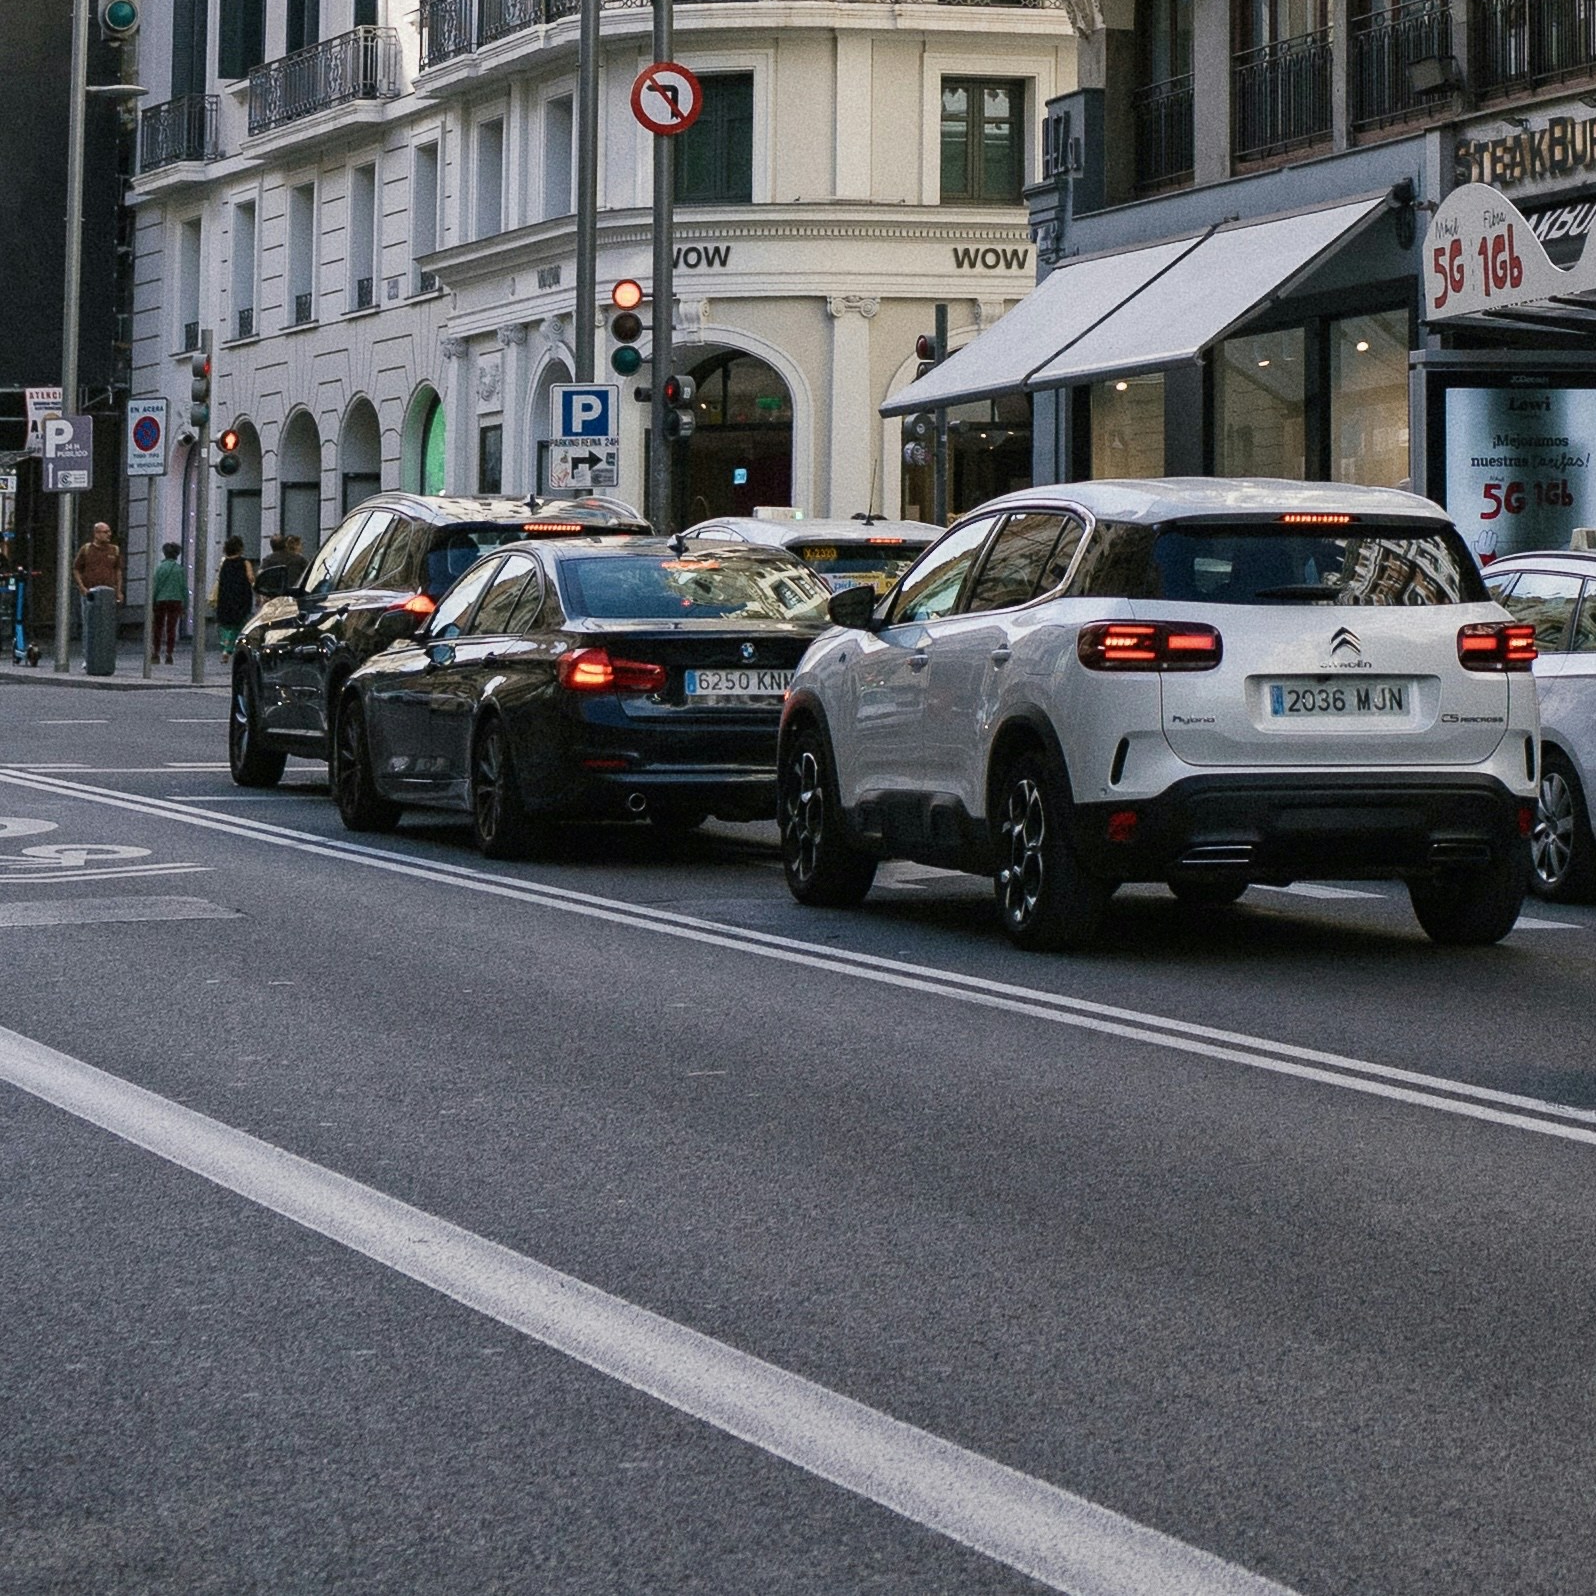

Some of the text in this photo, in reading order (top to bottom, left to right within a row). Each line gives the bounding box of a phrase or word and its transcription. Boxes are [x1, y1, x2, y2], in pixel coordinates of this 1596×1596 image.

[953, 247, 1029, 270] WOW
[1434, 224, 1524, 309] 5G 1Gb
[29, 391, 62, 400] ATENCI
[1509, 396, 1551, 411] Lowi
[571, 394, 603, 433] P
[45, 419, 74, 458] P
[1492, 434, 1569, 449] ¡Mejoramos
[1471, 455, 1529, 468] nuestras
[1480, 479, 1574, 520] 5G 1Gb
[698, 671, 750, 690] 6250
[1287, 687, 1404, 713] 2036 MJN
[1441, 713, 1459, 723] C5
